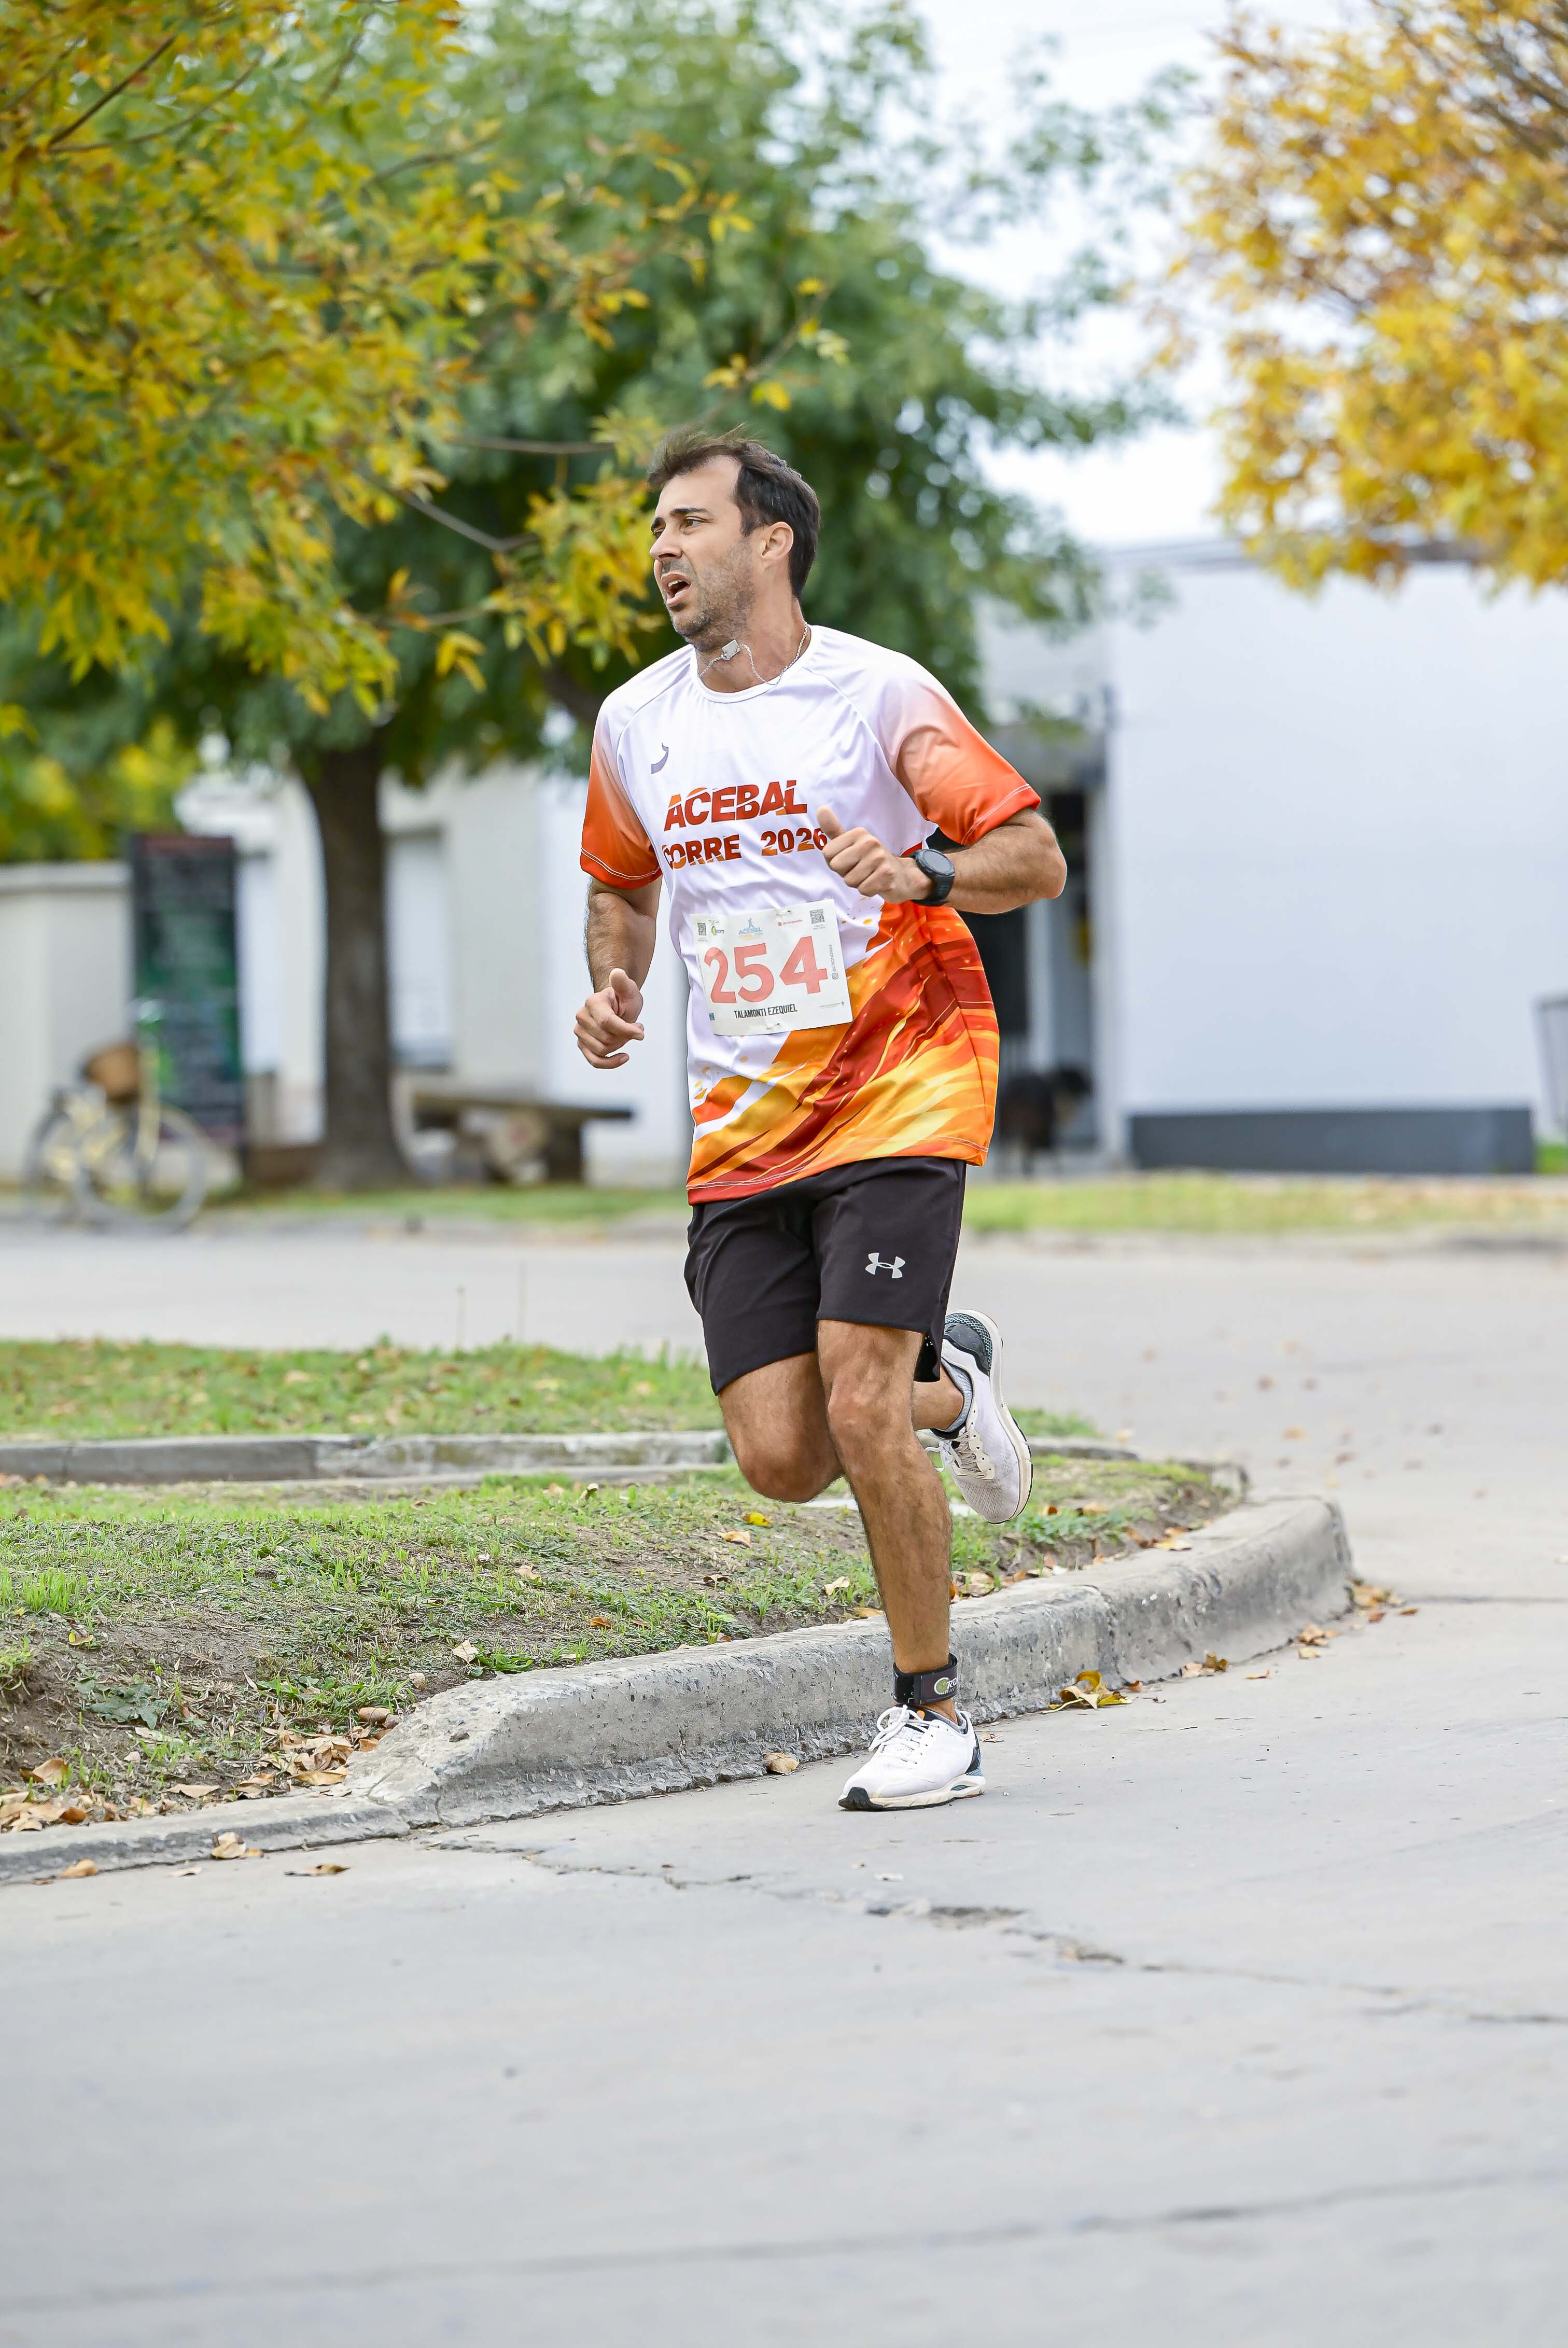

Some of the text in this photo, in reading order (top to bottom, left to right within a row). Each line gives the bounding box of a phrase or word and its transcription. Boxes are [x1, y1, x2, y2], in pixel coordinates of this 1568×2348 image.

[664, 780, 807, 831] ACEBAL
[662, 827, 829, 870] CORRE 2026
[704, 935, 828, 1004] 254
[734, 1004, 798, 1018] TALAMONTI EZEQUIEL
